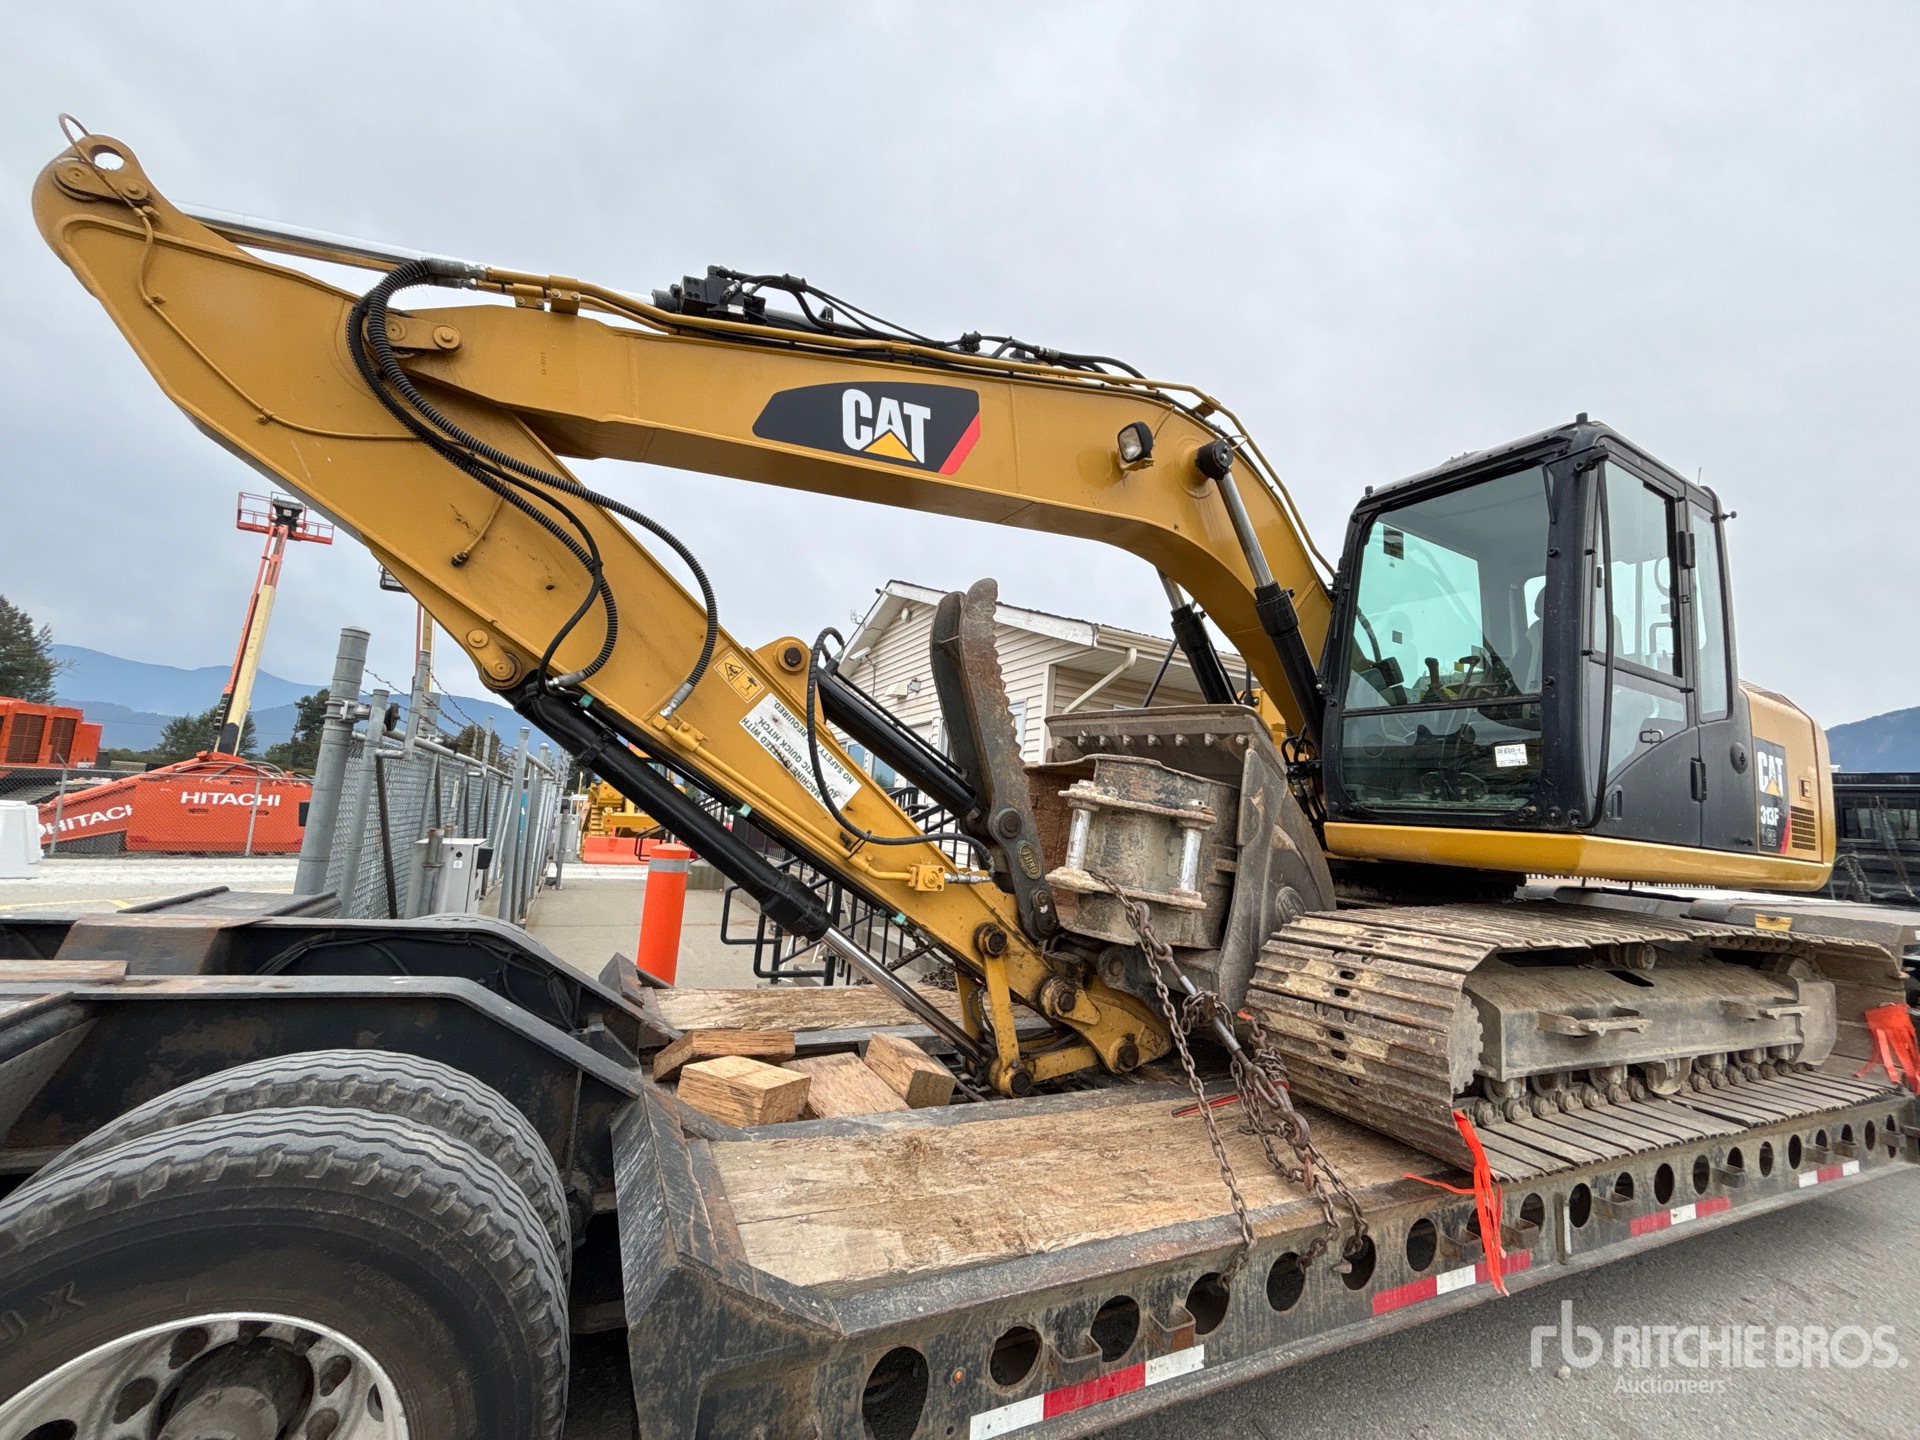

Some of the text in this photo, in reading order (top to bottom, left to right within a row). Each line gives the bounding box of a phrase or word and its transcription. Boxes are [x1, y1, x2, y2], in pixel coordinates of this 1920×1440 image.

[842, 389, 931, 464] CAT
[741, 717, 762, 738] WITH
[760, 716, 781, 741] HITCH.
[774, 699, 854, 784] NO SAFETY REQUIRED.
[780, 739, 802, 763] QUICK
[1757, 751, 1784, 797] CAT
[180, 791, 281, 807] HITACHI
[1760, 805, 1780, 826] 313F
